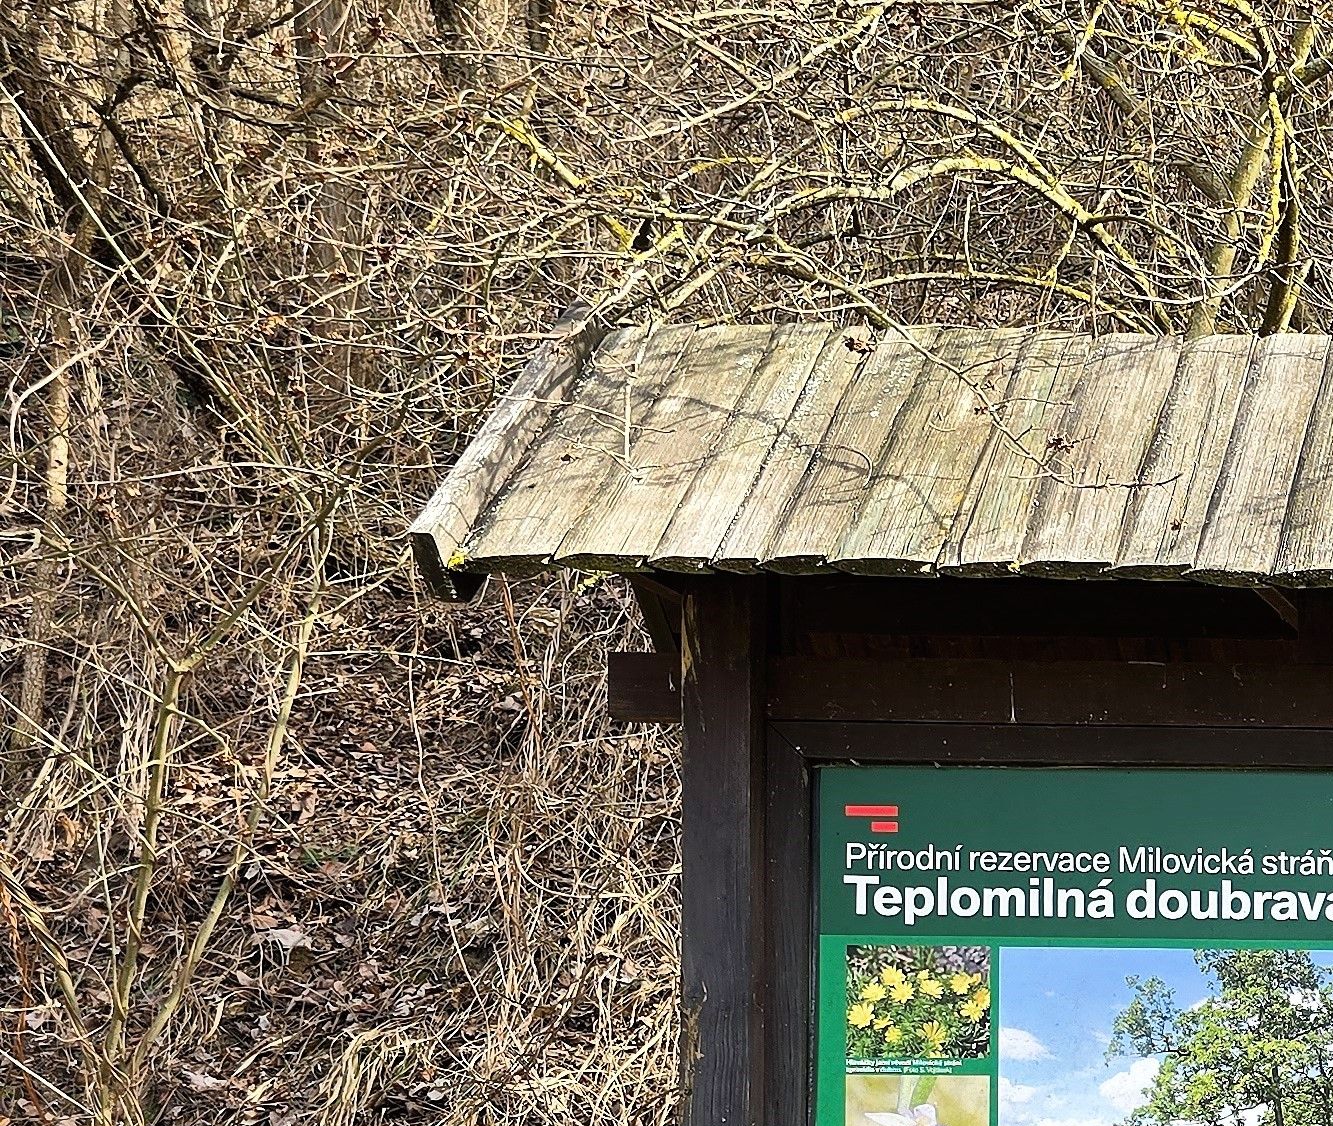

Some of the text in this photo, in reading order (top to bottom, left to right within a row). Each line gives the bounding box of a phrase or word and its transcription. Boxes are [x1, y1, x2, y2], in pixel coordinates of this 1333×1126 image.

[844, 841, 1333, 876] Přírodní rezervace Milovická stráň
[843, 873, 1116, 925] Teplomilná
